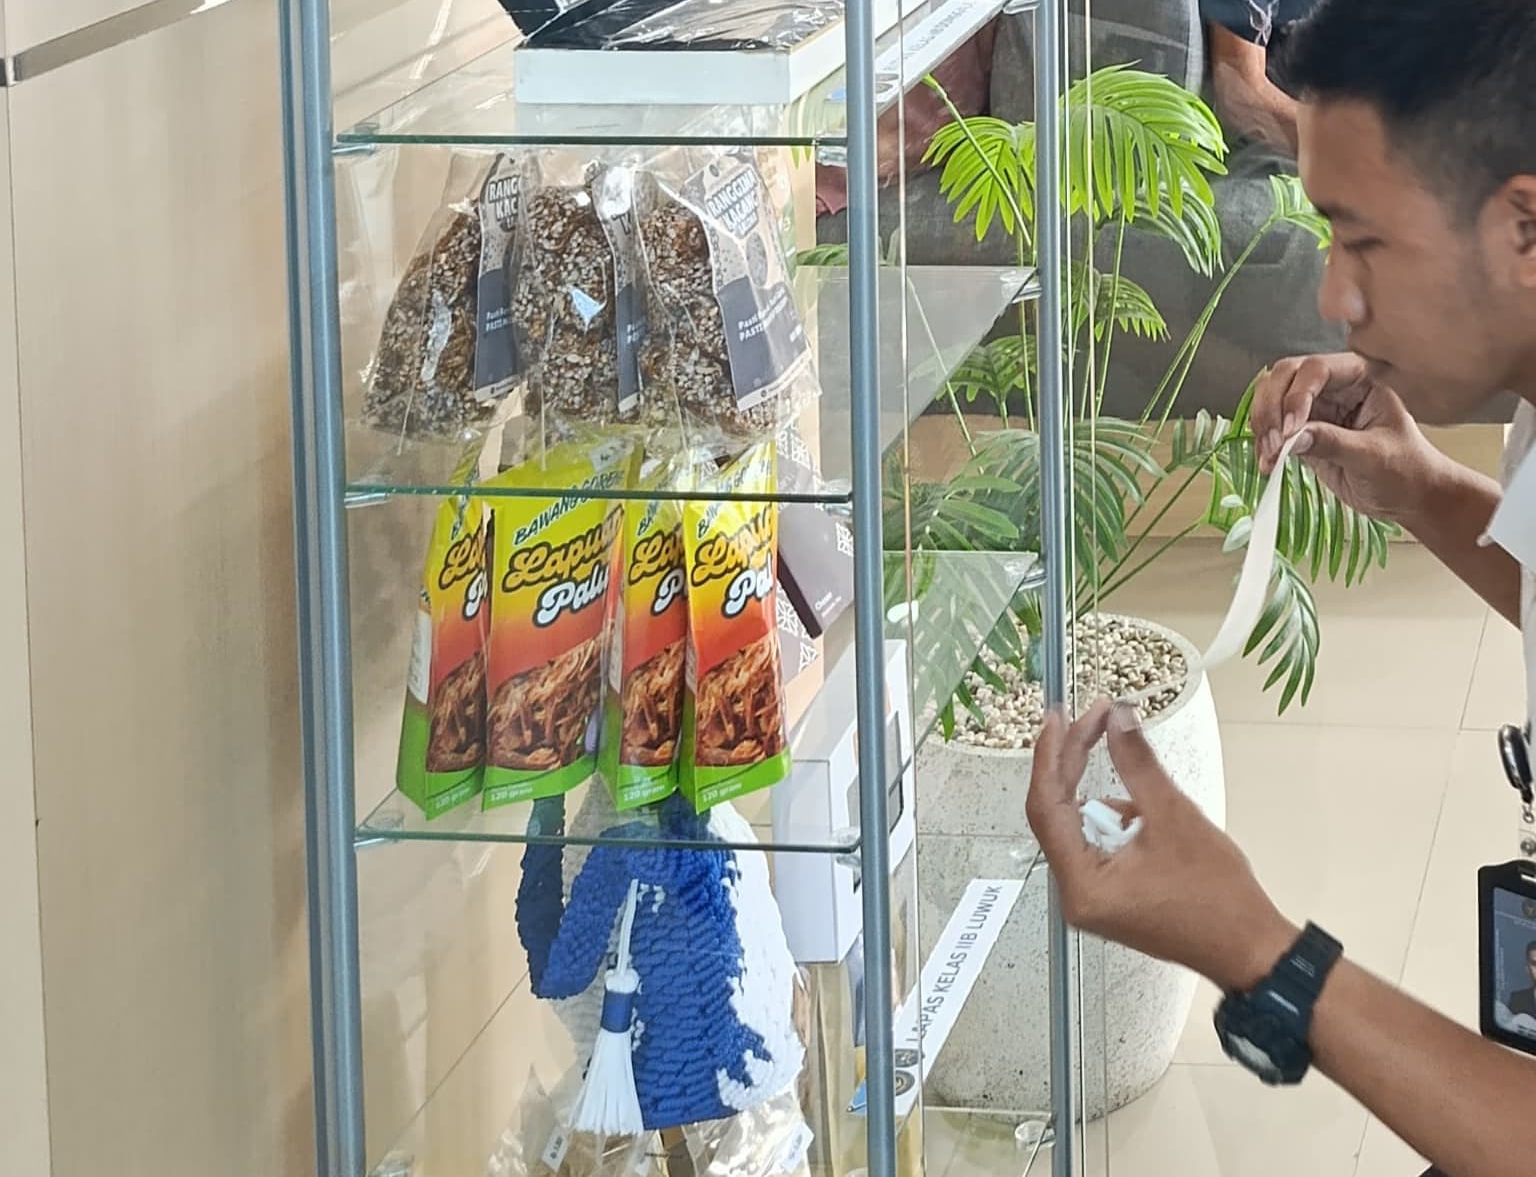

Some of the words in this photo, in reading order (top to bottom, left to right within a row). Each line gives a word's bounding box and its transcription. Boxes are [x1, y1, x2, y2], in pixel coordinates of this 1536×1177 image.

[936, 951, 967, 994] KELAS
[957, 930, 977, 950] IIB
[971, 885, 1003, 930] LUWUK
